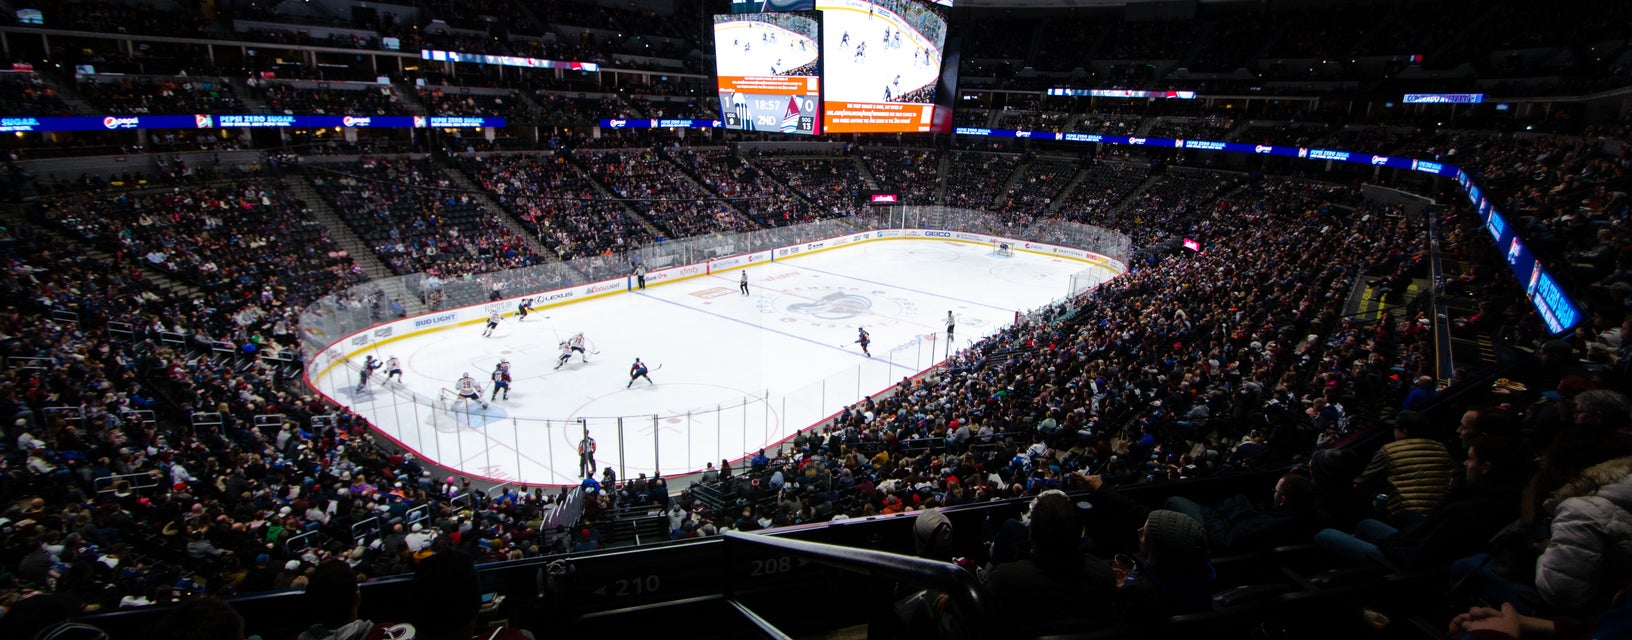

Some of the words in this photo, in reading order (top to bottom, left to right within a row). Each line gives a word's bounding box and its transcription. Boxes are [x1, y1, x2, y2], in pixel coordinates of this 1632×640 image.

[724, 96, 730, 108] 1
[755, 100, 780, 111] 18:57
[805, 100, 813, 112] 0
[117, 117, 139, 125] pepsi
[758, 115, 776, 126] 2ND
[680, 266, 698, 276] xfinity
[545, 291, 573, 301] LEXUS
[415, 318, 432, 327] BUD
[433, 314, 455, 324] LIGHT
[752, 556, 791, 577] 208
[616, 575, 659, 597] 210
